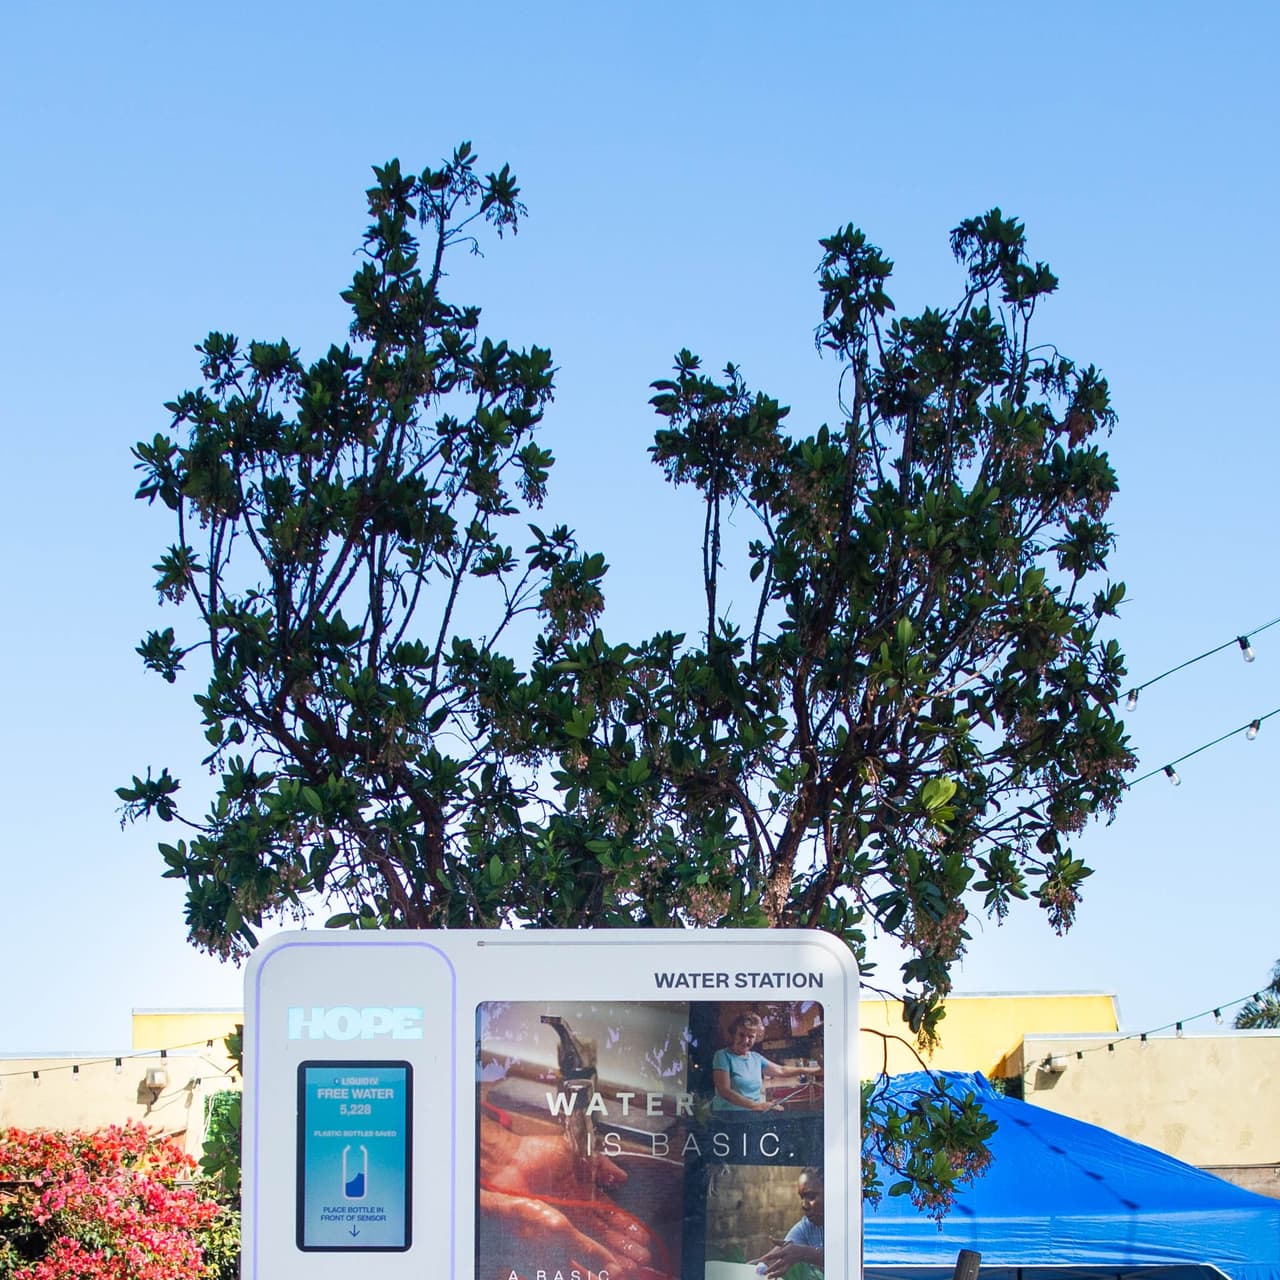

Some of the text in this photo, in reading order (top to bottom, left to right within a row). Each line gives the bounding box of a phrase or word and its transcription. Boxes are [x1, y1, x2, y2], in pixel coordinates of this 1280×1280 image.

[654, 972, 824, 989] WATER STATION
[287, 1006, 424, 1041] HOPE
[317, 1088, 394, 1099] FREE WATER
[545, 1092, 696, 1117] WATER
[587, 1132, 795, 1157] IS BASIC.
[320, 1214, 387, 1222] FRONT OF SENSOR
[322, 1206, 385, 1214] PLACE BOTTLE IN
